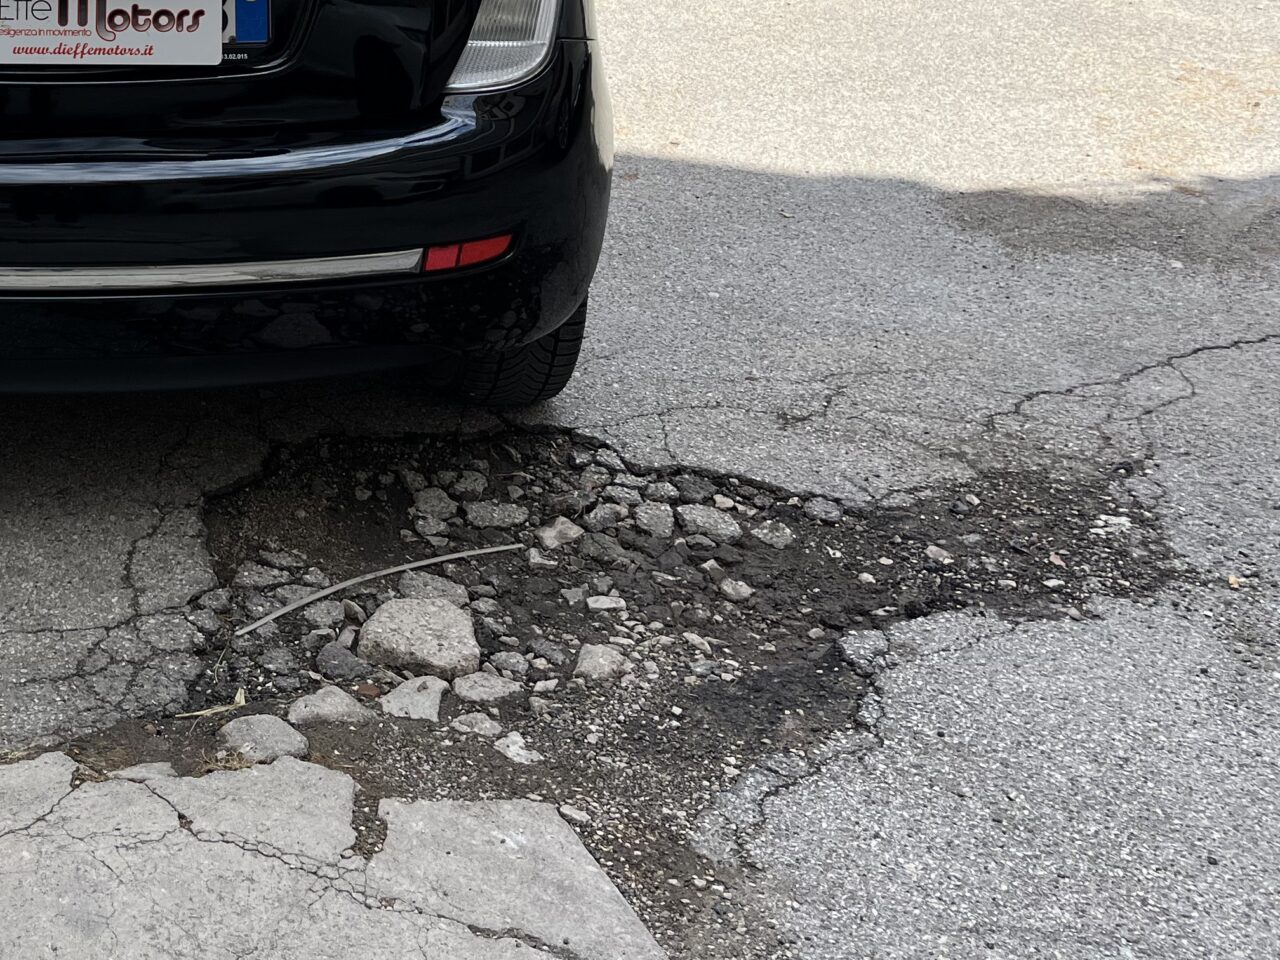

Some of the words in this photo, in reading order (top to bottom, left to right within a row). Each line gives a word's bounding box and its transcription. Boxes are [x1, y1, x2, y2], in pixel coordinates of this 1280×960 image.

[38, 27, 46, 36] in
[46, 27, 93, 37] movimento
[12, 42, 155, 59] www.dieffemotors.it
